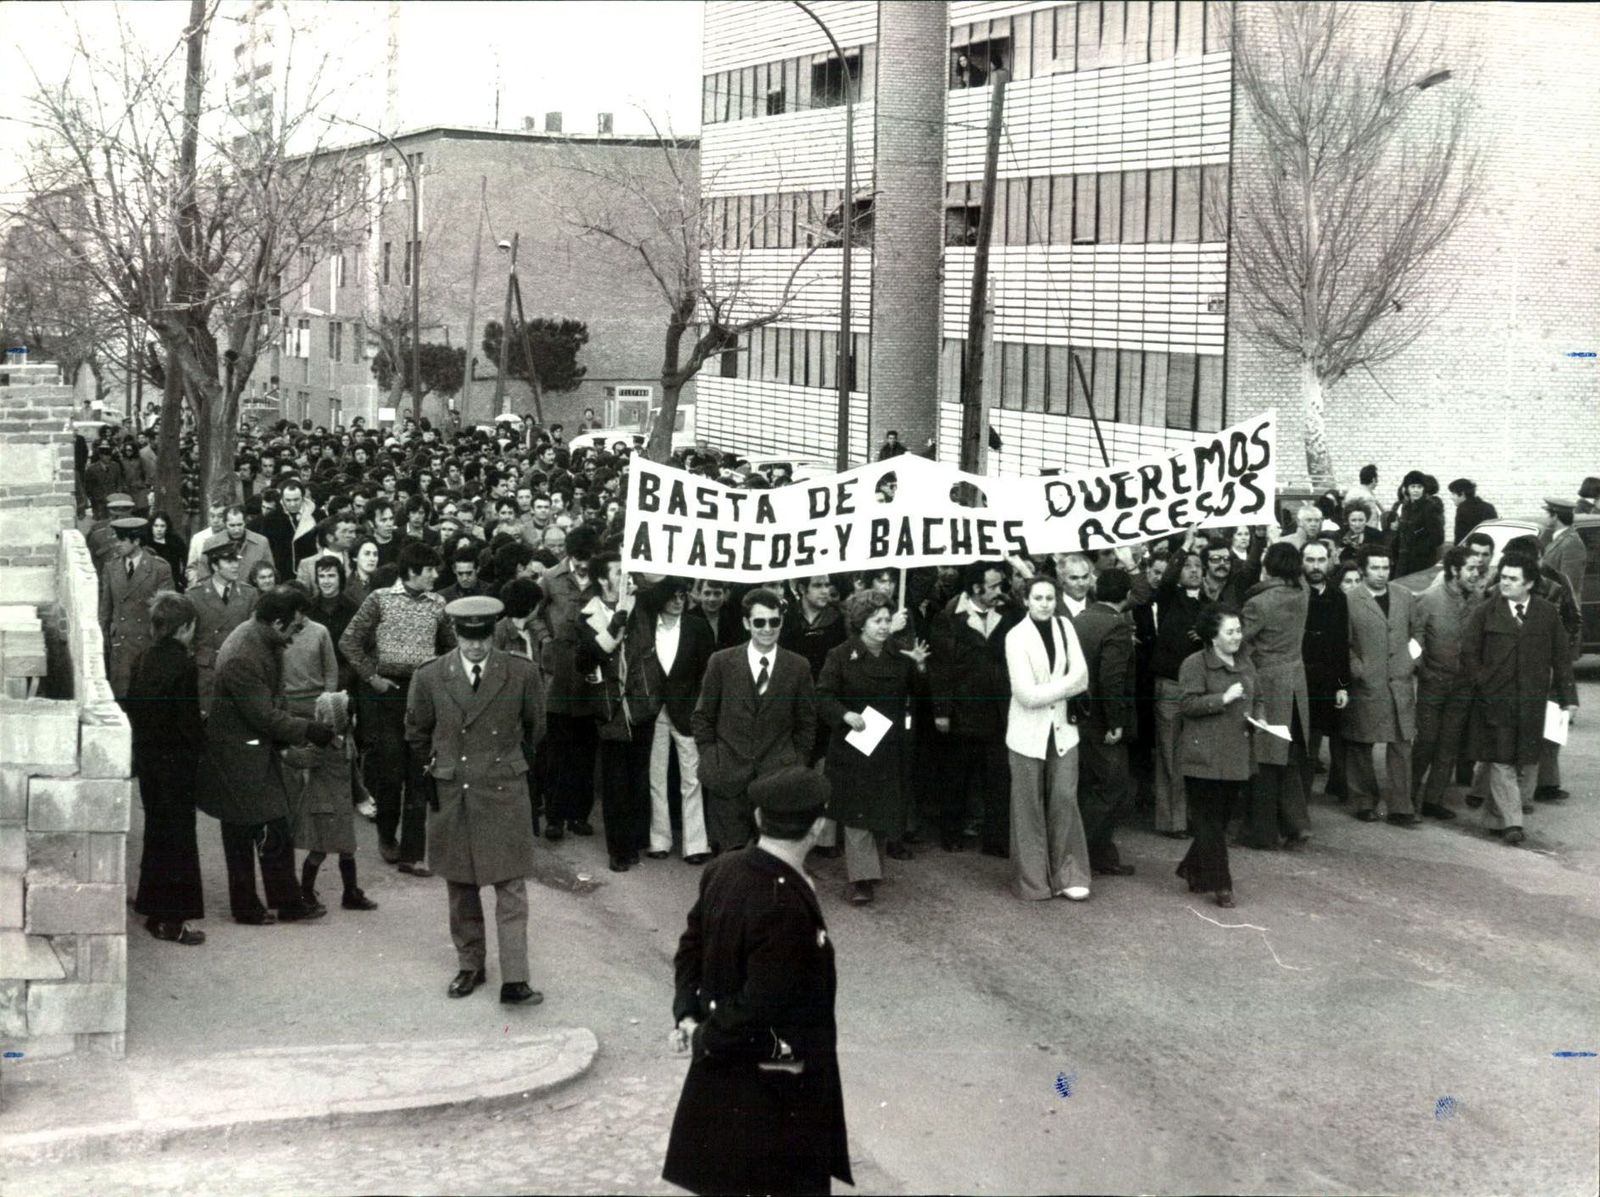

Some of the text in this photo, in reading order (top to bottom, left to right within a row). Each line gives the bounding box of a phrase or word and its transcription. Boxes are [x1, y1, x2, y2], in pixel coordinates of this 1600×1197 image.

[638, 471, 859, 524] BASTA DE
[1045, 421, 1271, 522] QUEREMOS
[868, 516, 1030, 558] BACHES
[1077, 472, 1266, 550] ACCESOS
